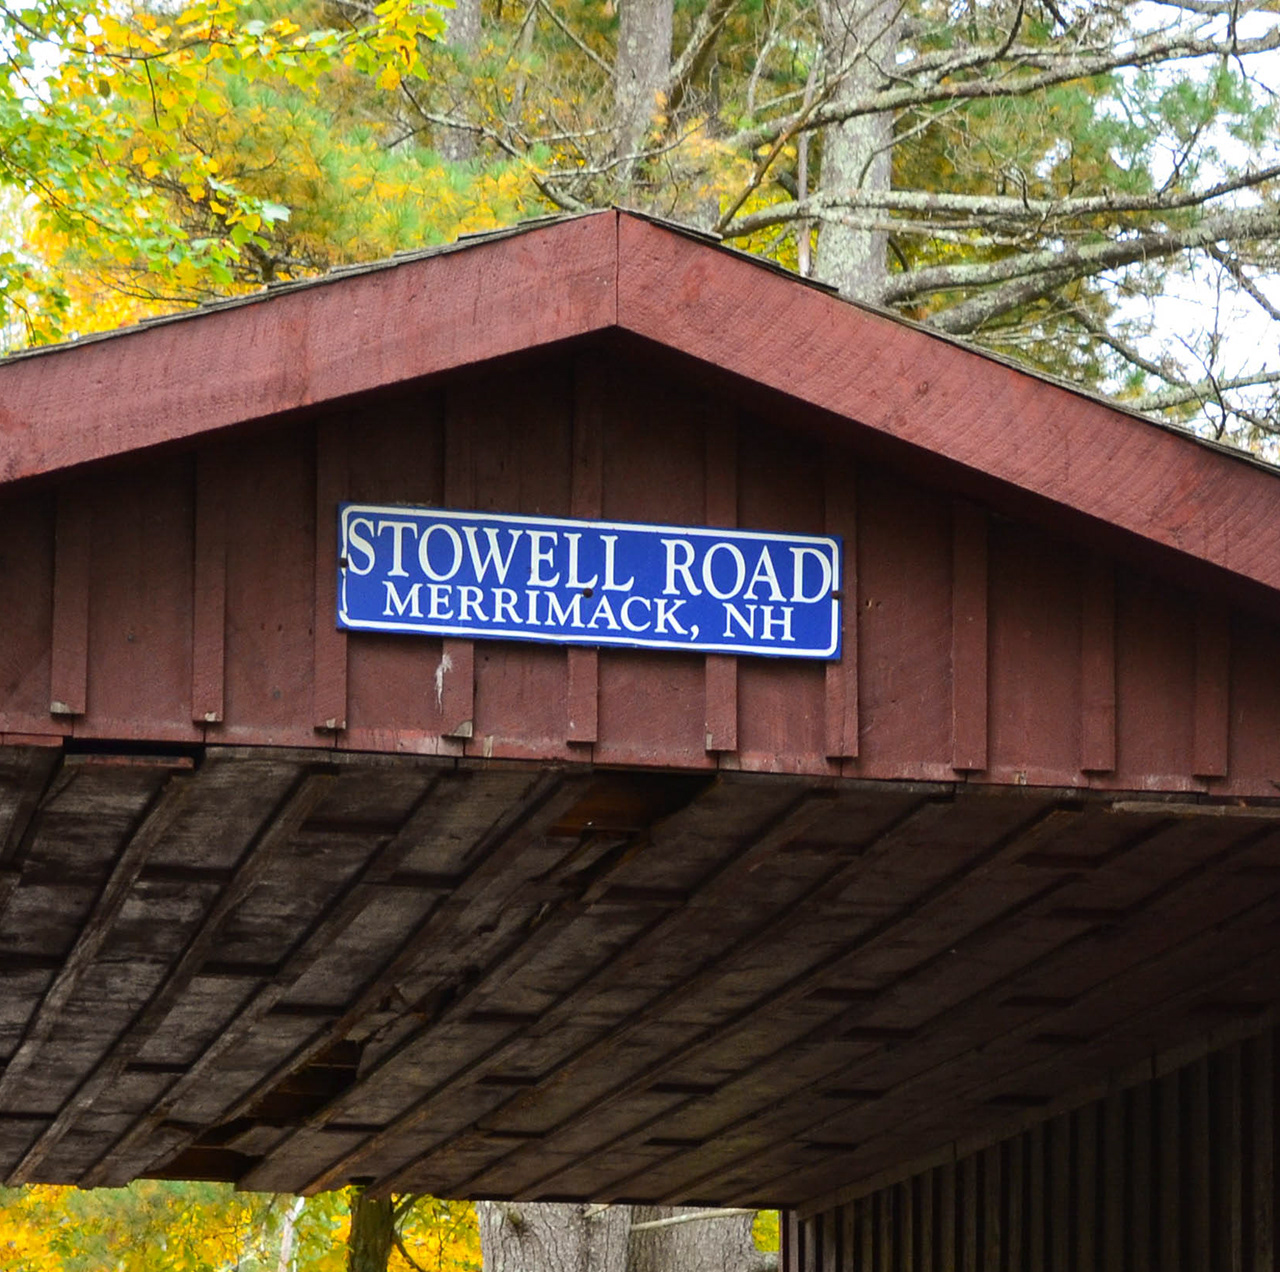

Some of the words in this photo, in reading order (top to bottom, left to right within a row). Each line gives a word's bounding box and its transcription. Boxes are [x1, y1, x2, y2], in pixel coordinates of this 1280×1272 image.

[347, 518, 634, 591] STOWELL
[661, 538, 832, 603] ROAD
[382, 581, 700, 641] MERRIMACK,
[722, 602, 796, 641] NH
